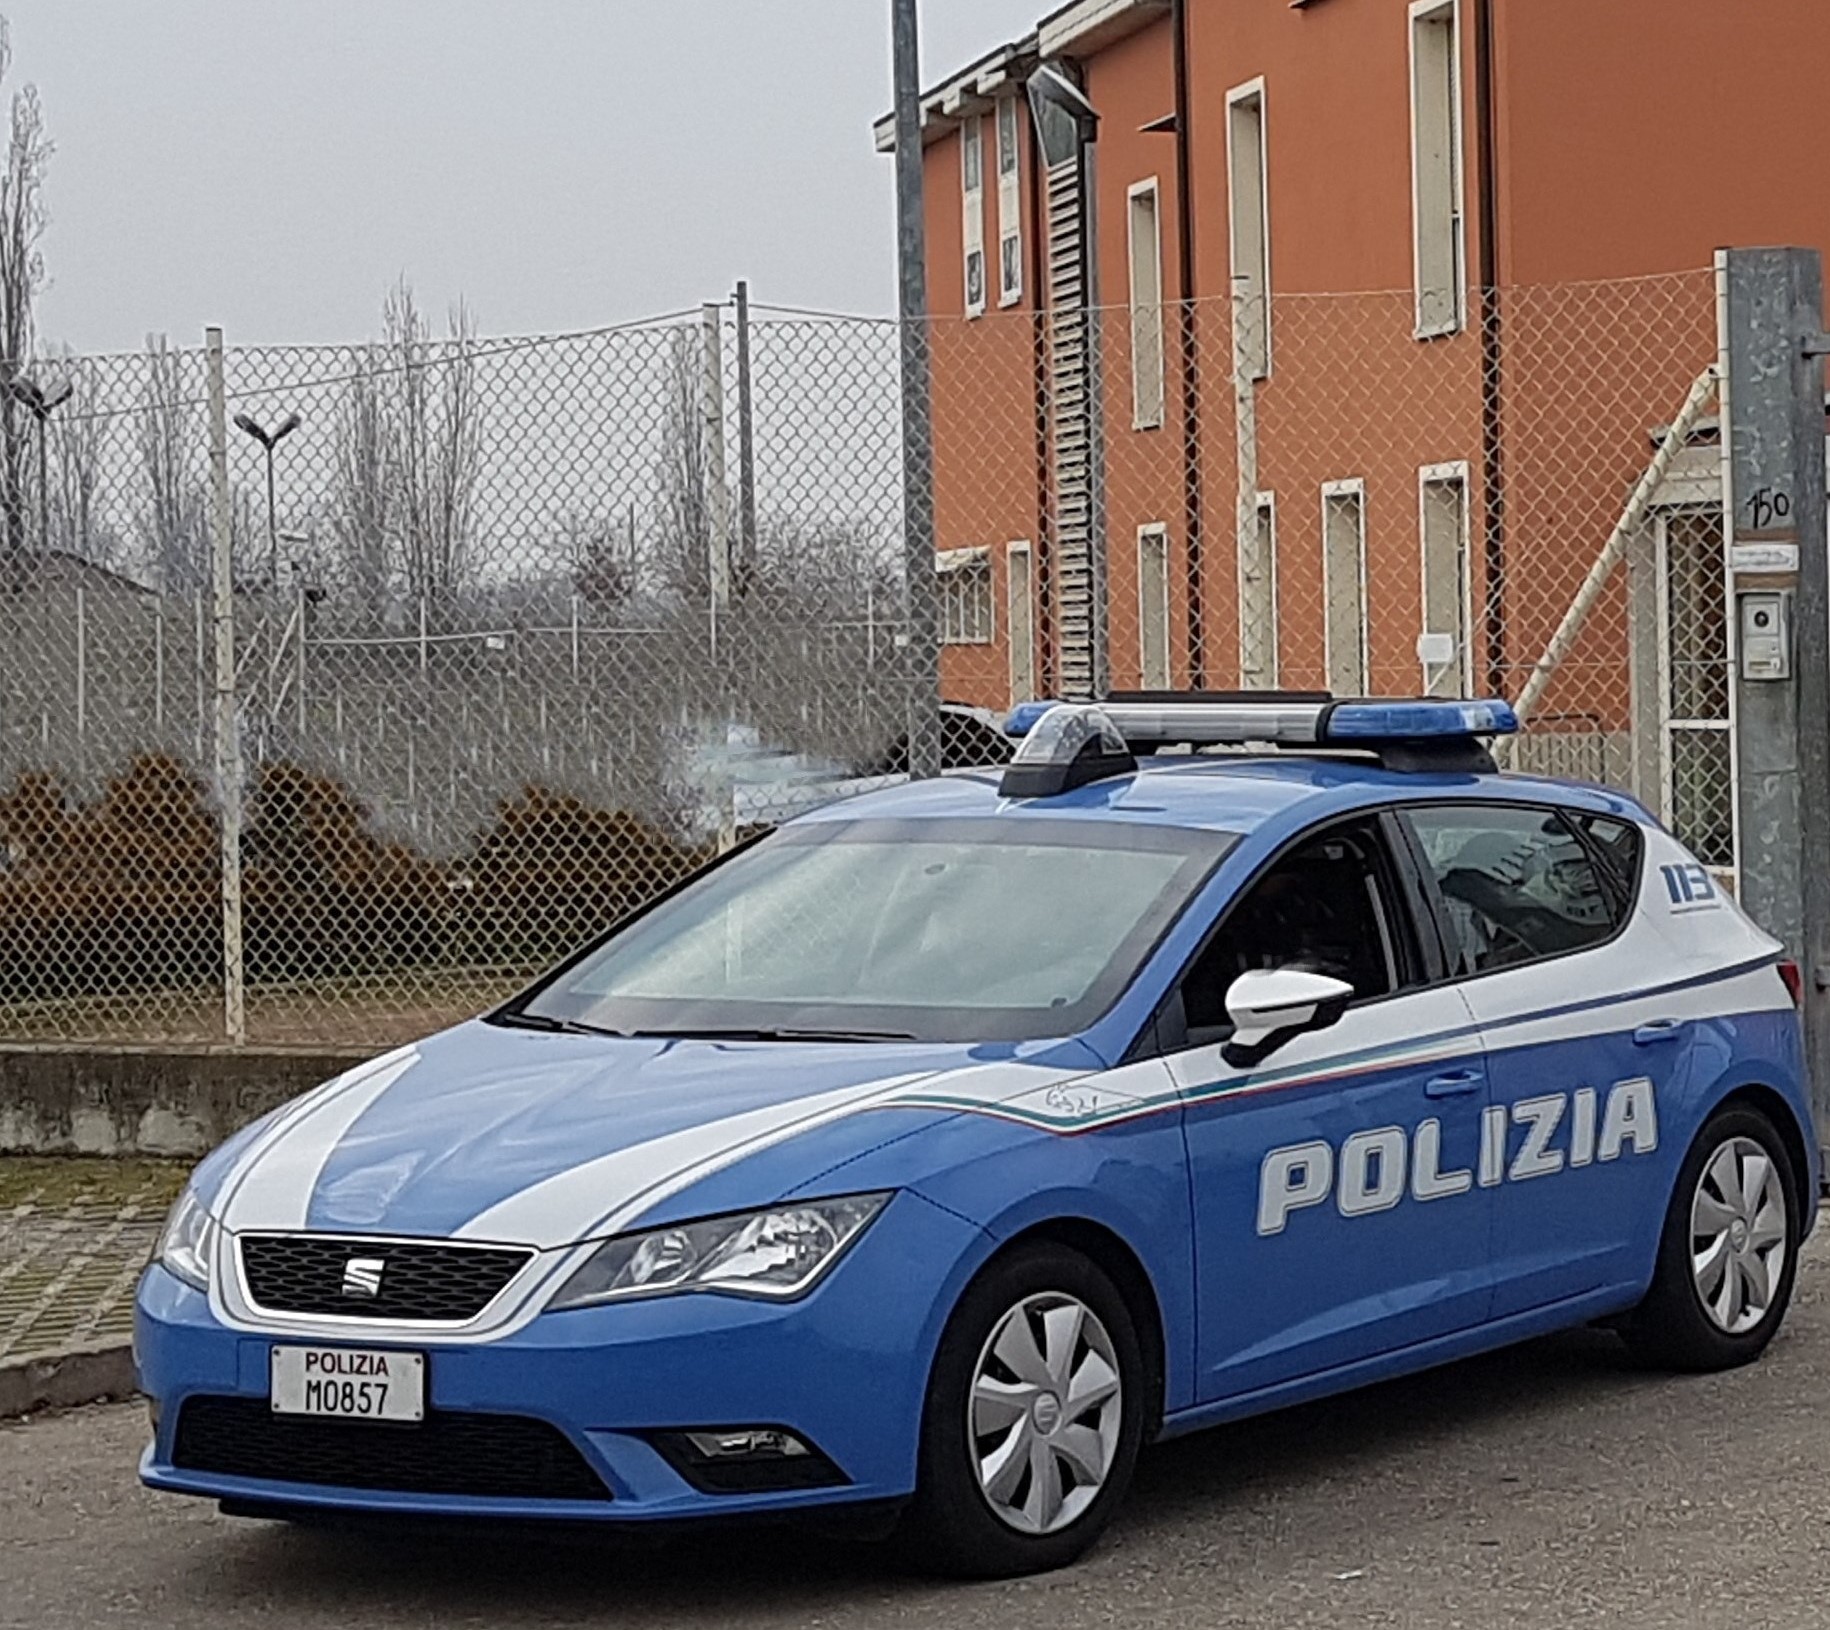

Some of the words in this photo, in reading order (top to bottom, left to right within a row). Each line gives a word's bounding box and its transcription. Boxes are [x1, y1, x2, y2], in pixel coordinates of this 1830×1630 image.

[1745, 486, 1790, 530] 150
[1659, 863, 1716, 904] 113
[1256, 1075, 1659, 1238] POLIZIA
[305, 1351, 389, 1376] POLIZIA
[305, 1379, 389, 1416] M0857
